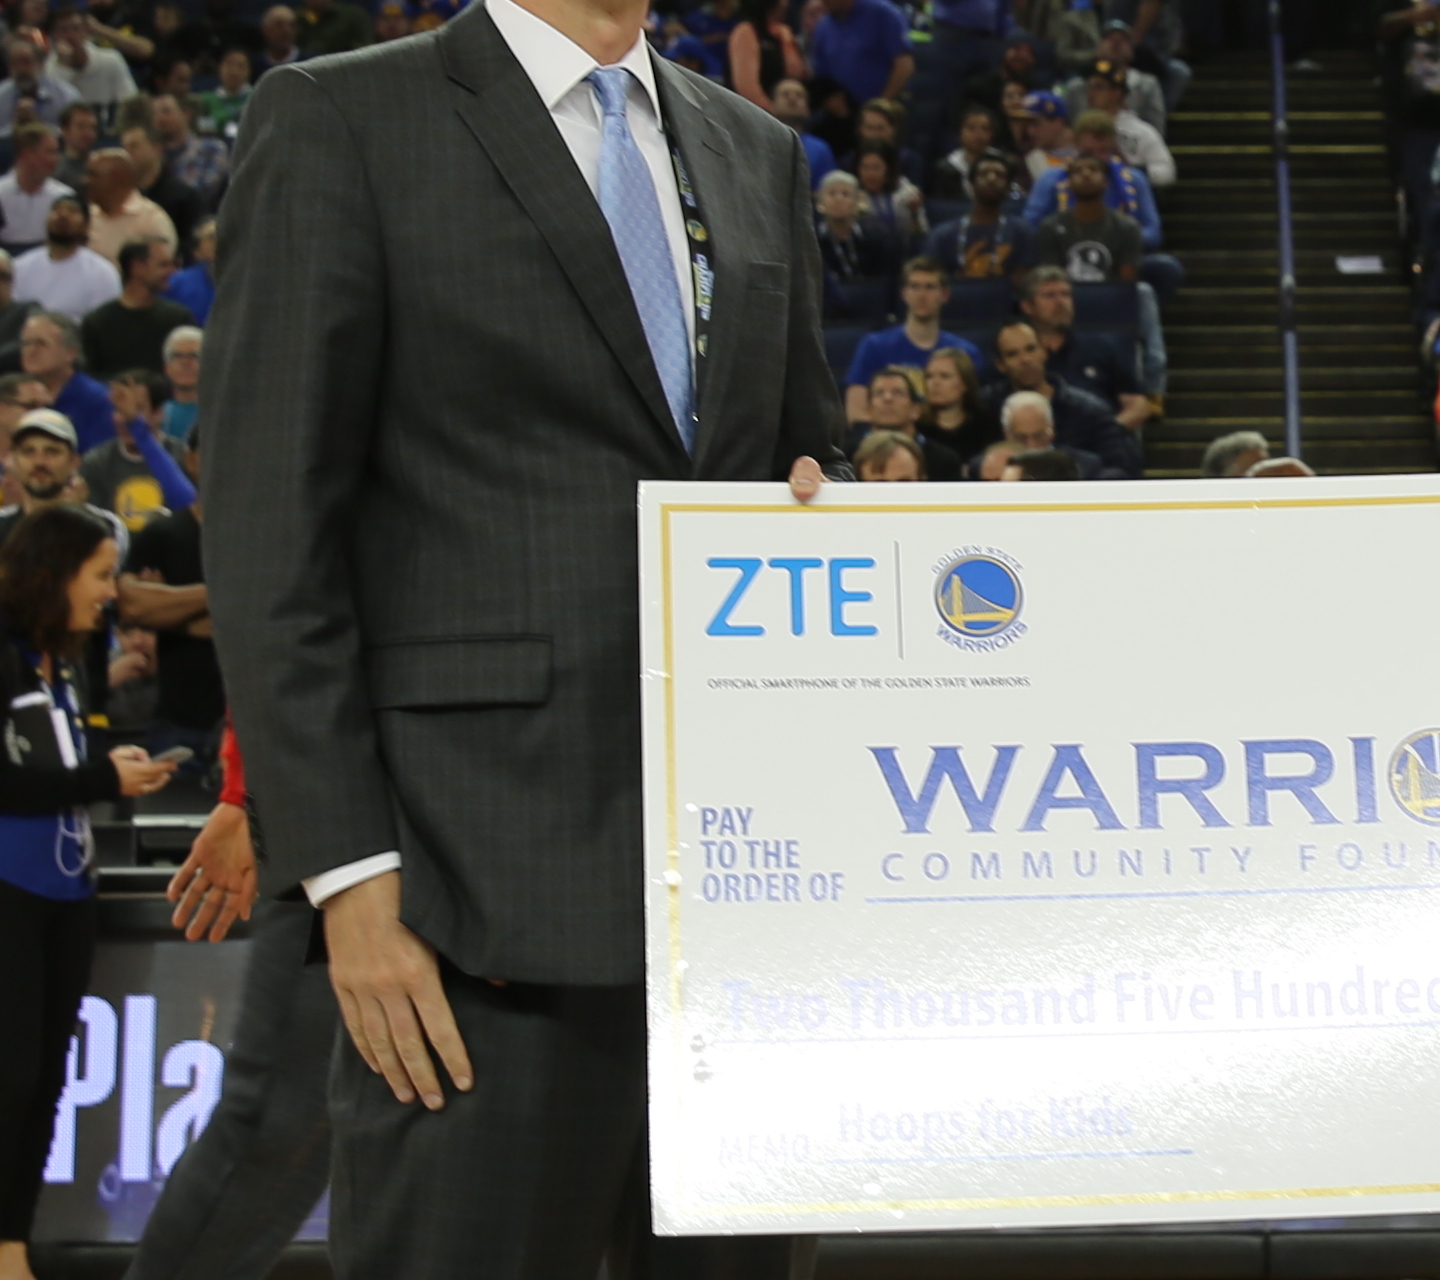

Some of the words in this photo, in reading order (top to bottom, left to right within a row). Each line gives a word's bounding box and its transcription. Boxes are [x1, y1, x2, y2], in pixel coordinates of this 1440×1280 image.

[705, 558, 878, 636] ZTE
[708, 678, 760, 690] OFFICIAL
[761, 678, 840, 690] SMARTPHONE
[842, 678, 858, 689] OF
[860, 678, 883, 689] THE
[885, 678, 933, 688] GOLDEN
[935, 677, 968, 688] STATE
[969, 676, 1031, 688] WARRIORS
[701, 806, 753, 835] PAY
[700, 840, 737, 869] TO
[744, 840, 800, 868] THE
[882, 847, 1251, 881] COMMUNITY
[703, 873, 801, 902] ORDER
[810, 872, 844, 901] OF
[720, 979, 827, 1030] Two
[842, 975, 1094, 1028] Thousand
[1115, 972, 1216, 1021] Five
[838, 1103, 960, 1152] Hoops
[978, 1100, 1035, 1138] for
[1049, 1096, 1133, 1137] Kids
